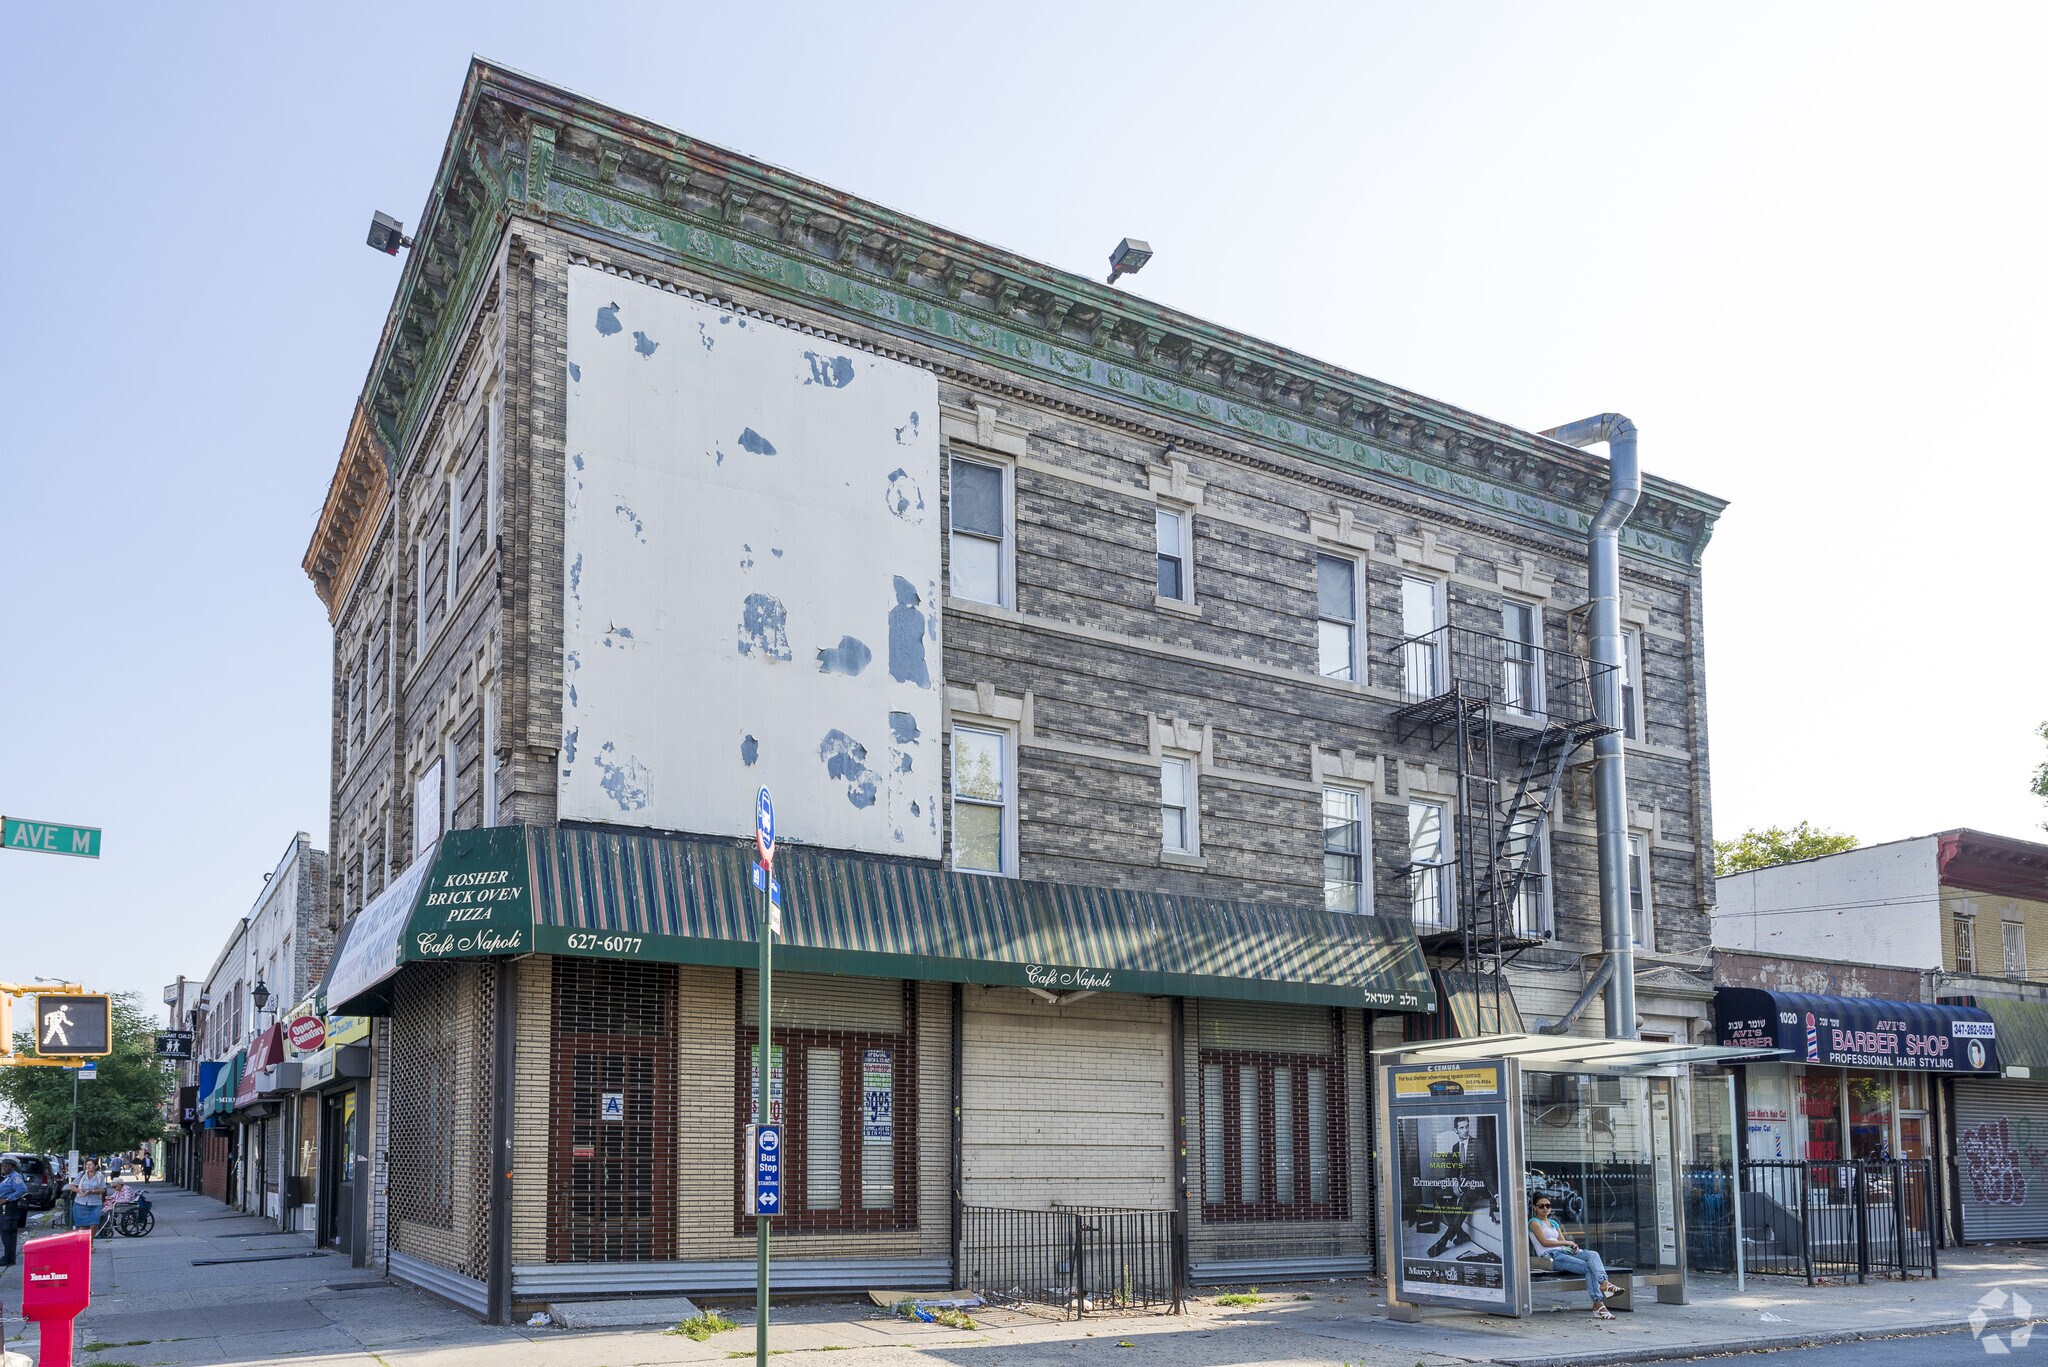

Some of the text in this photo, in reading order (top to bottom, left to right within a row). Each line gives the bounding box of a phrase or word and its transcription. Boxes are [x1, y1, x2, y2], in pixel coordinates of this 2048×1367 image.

[12, 823, 90, 853] AVE M
[443, 870, 509, 888] KOSHER
[425, 886, 523, 906] BRICK OVEN
[446, 907, 493, 922] PIZZA
[416, 928, 522, 956] Café Napoli
[567, 933, 643, 954] 627-6077
[1025, 964, 1112, 989] Café Napoli
[1364, 989, 1418, 1006] חלב ישראל
[1747, 1019, 1766, 1028] שומר
[1779, 1012, 1798, 1025] 1020
[1876, 1020, 1907, 1032] AVI'S
[292, 1020, 316, 1036] Open
[293, 1026, 325, 1046] Sunday
[1732, 1029, 1763, 1038] AVI'S
[1953, 1024, 1994, 1036] 347-262-0506
[1723, 1036, 1773, 1047] BARBER
[1832, 1029, 1950, 1056] BARBER SHOP
[1829, 1052, 1954, 1069] PROFESSIONAL HAIR STYLING
[605, 1096, 620, 1113] A
[1757, 1109, 1769, 1118] Men's
[1770, 1110, 1778, 1118] Hair
[1748, 1124, 1762, 1133] egular
[1814, 1119, 1825, 1139] AT
[761, 1153, 777, 1162] Bus
[1804, 1140, 1837, 1160] LOWEST
[759, 1163, 778, 1173] Stop
[1412, 1176, 1485, 1190] Ermenegildo Zegna
[1408, 1266, 1440, 1278] Marcy's
